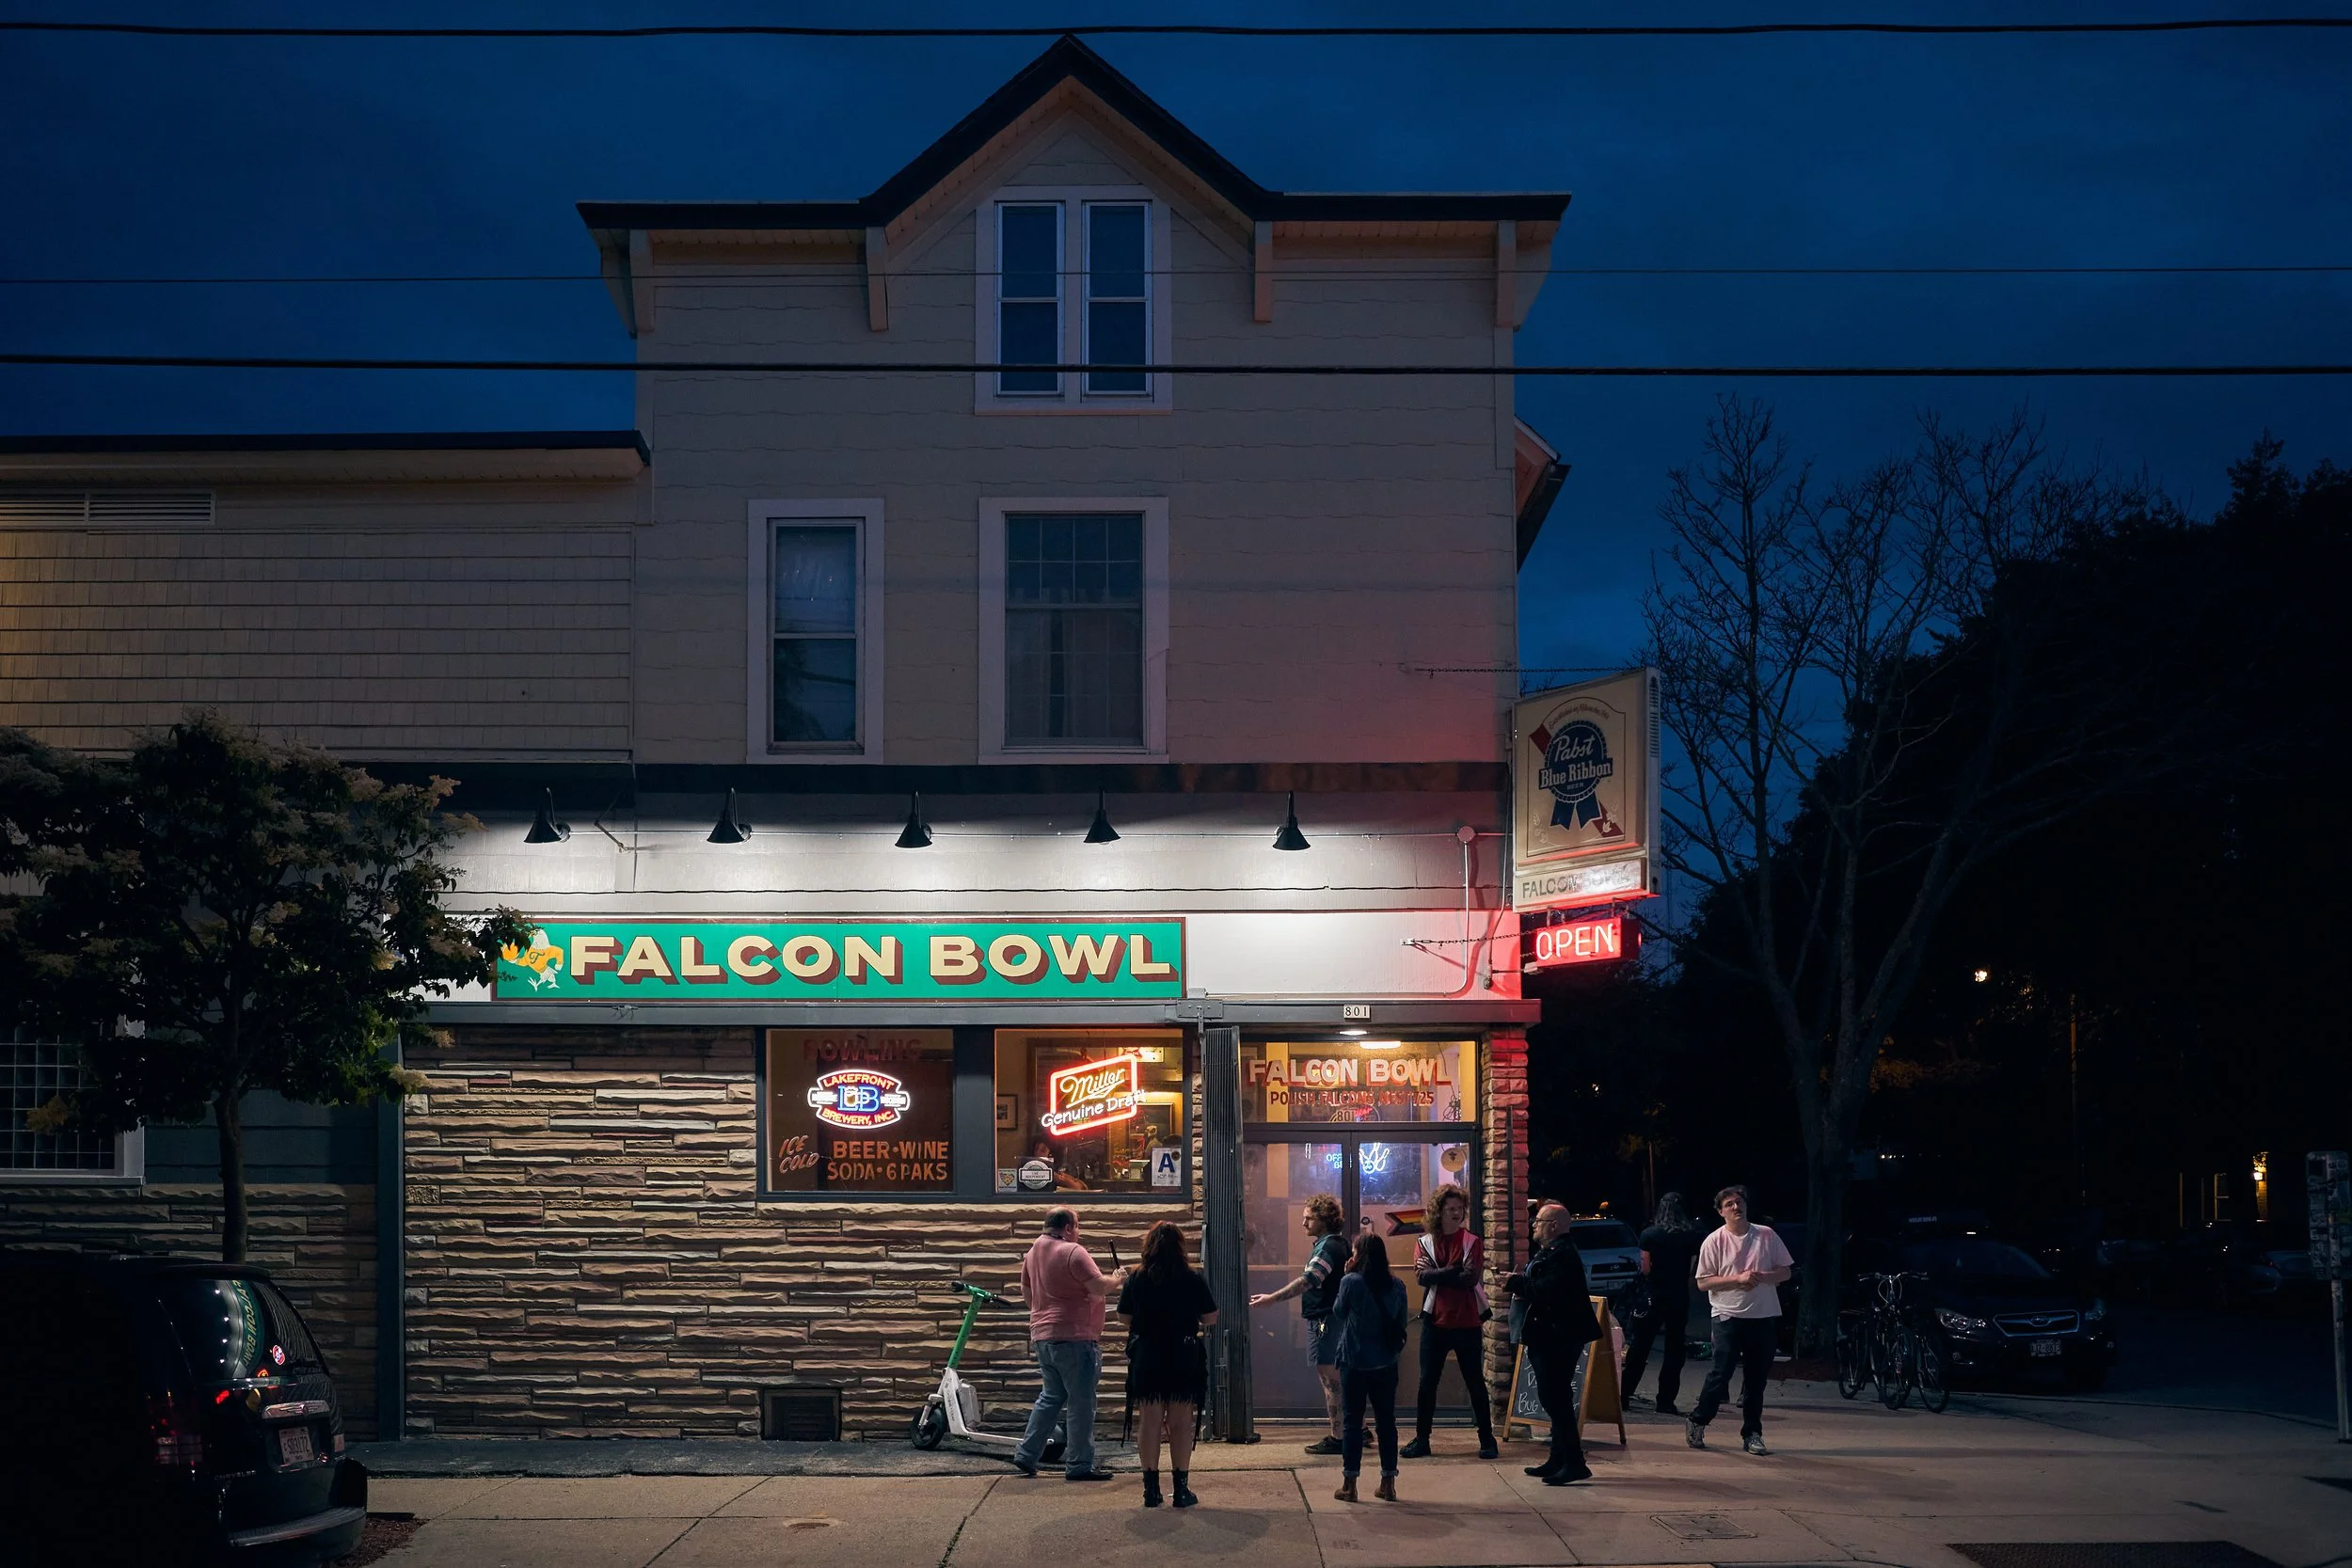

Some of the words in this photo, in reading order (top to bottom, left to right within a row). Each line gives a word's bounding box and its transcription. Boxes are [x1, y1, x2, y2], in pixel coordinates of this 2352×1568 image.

[1551, 735, 1596, 762] Pabst
[1540, 768, 1566, 787] Blue
[1568, 760, 1612, 783] Ribbon
[1536, 923, 1614, 960] OPEN
[569, 935, 904, 985] FALCON
[930, 934, 1179, 985] BOWL
[1344, 1006, 1369, 1017] 801
[822, 1073, 895, 1090] LAKEFRONT
[1248, 1058, 1359, 1086] FALCON
[1367, 1058, 1453, 1086] BOWL
[1059, 1068, 1126, 1103] Miller
[1041, 1102, 1104, 1128] Genuine
[778, 1134, 809, 1156] ICE
[779, 1152, 820, 1174] COLD
[899, 1162, 947, 1181] PAKS
[1158, 1153, 1175, 1173] A
